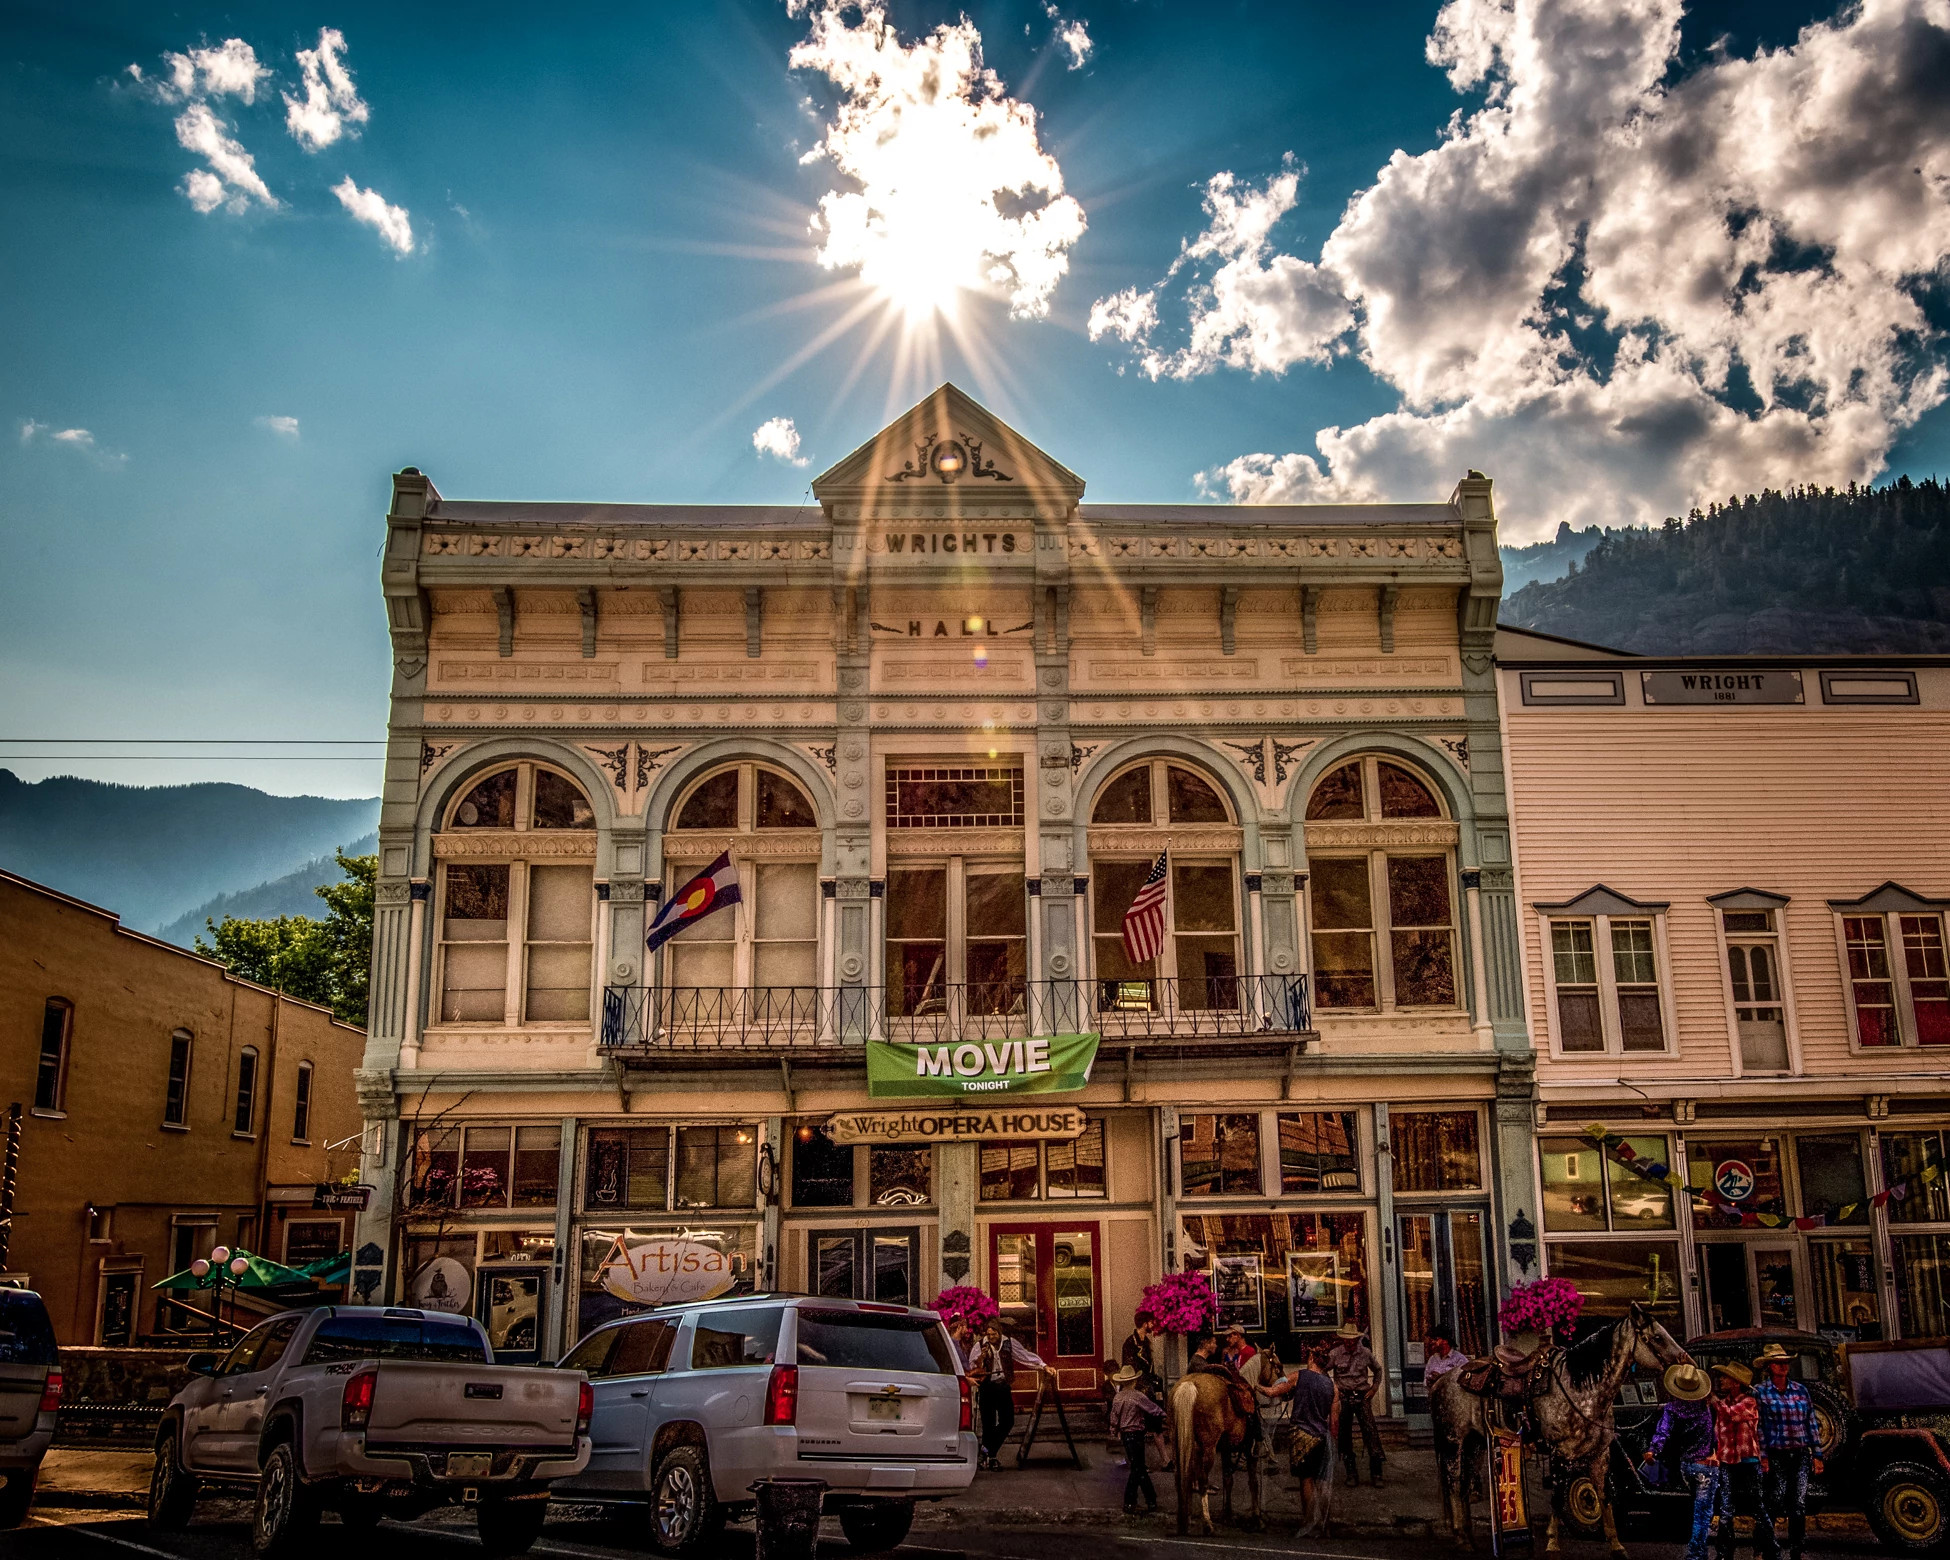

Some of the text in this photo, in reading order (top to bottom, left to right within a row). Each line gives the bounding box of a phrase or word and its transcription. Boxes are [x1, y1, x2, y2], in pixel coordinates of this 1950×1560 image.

[886, 533, 1015, 553] WRIGHTS
[908, 620, 998, 636] HALL
[1681, 675, 1764, 690] WRIGHT
[1714, 692, 1736, 700] 1881
[916, 1039, 1051, 1077] MOVIE
[962, 1080, 1010, 1091] TONIGHT
[852, 1113, 1076, 1139] Wright OPERA HOUSE
[590, 1235, 748, 1283] Artisan
[633, 1282, 670, 1295] Bakery
[417, 1425, 536, 1437] TACOMA
